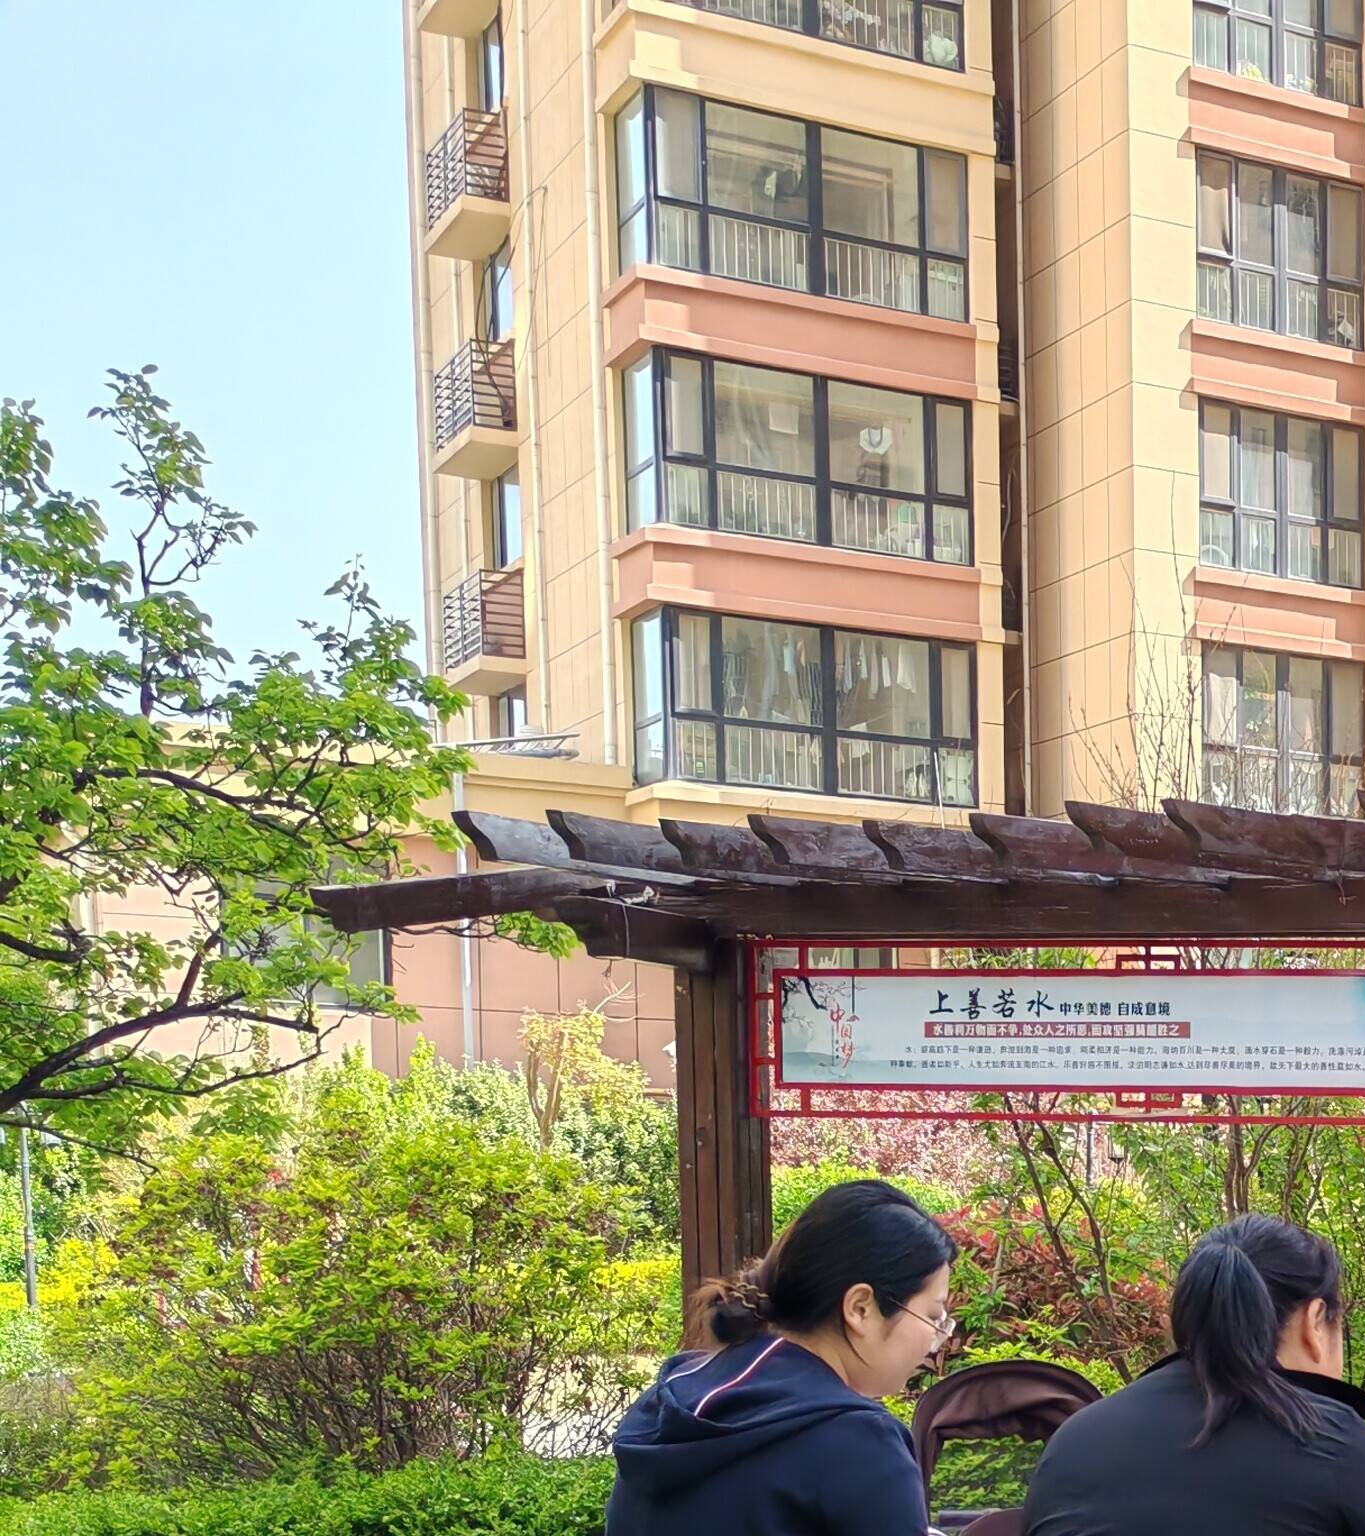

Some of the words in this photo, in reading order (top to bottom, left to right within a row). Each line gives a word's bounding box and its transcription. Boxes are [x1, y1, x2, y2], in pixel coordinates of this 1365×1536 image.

[928, 987, 1055, 1021] 上善若水
[1059, 1001, 1112, 1017] 中华美德
[1117, 1001, 1171, 1017] 自成意境
[830, 1003, 856, 1069] 中国梦
